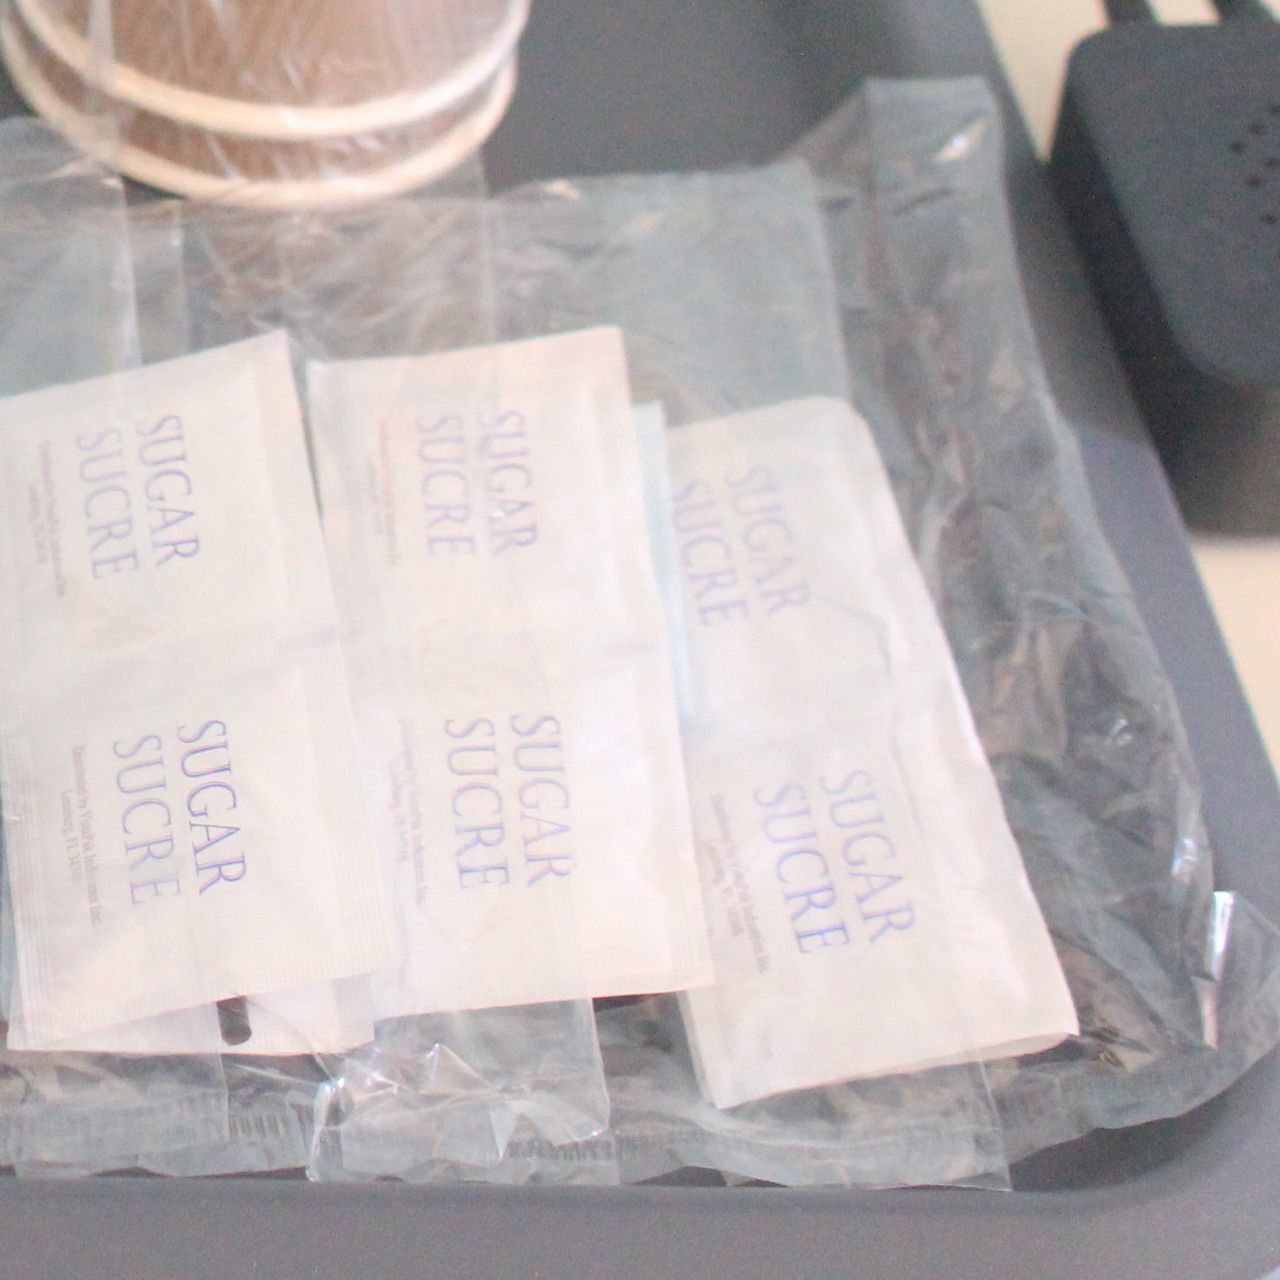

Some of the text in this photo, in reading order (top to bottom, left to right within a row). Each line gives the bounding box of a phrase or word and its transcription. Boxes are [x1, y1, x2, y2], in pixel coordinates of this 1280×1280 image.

[76, 428, 140, 580] SUCRE
[135, 414, 201, 568] SUGAR
[416, 414, 477, 556] SUCRE
[479, 409, 540, 556] SUGAR
[113, 734, 180, 905] SUCRE
[177, 719, 247, 895] SUGAR
[444, 717, 510, 889] SUCRE
[510, 713, 576, 888] SUGAR
[753, 782, 851, 954] SUCRE
[820, 769, 917, 944] SUGAR
